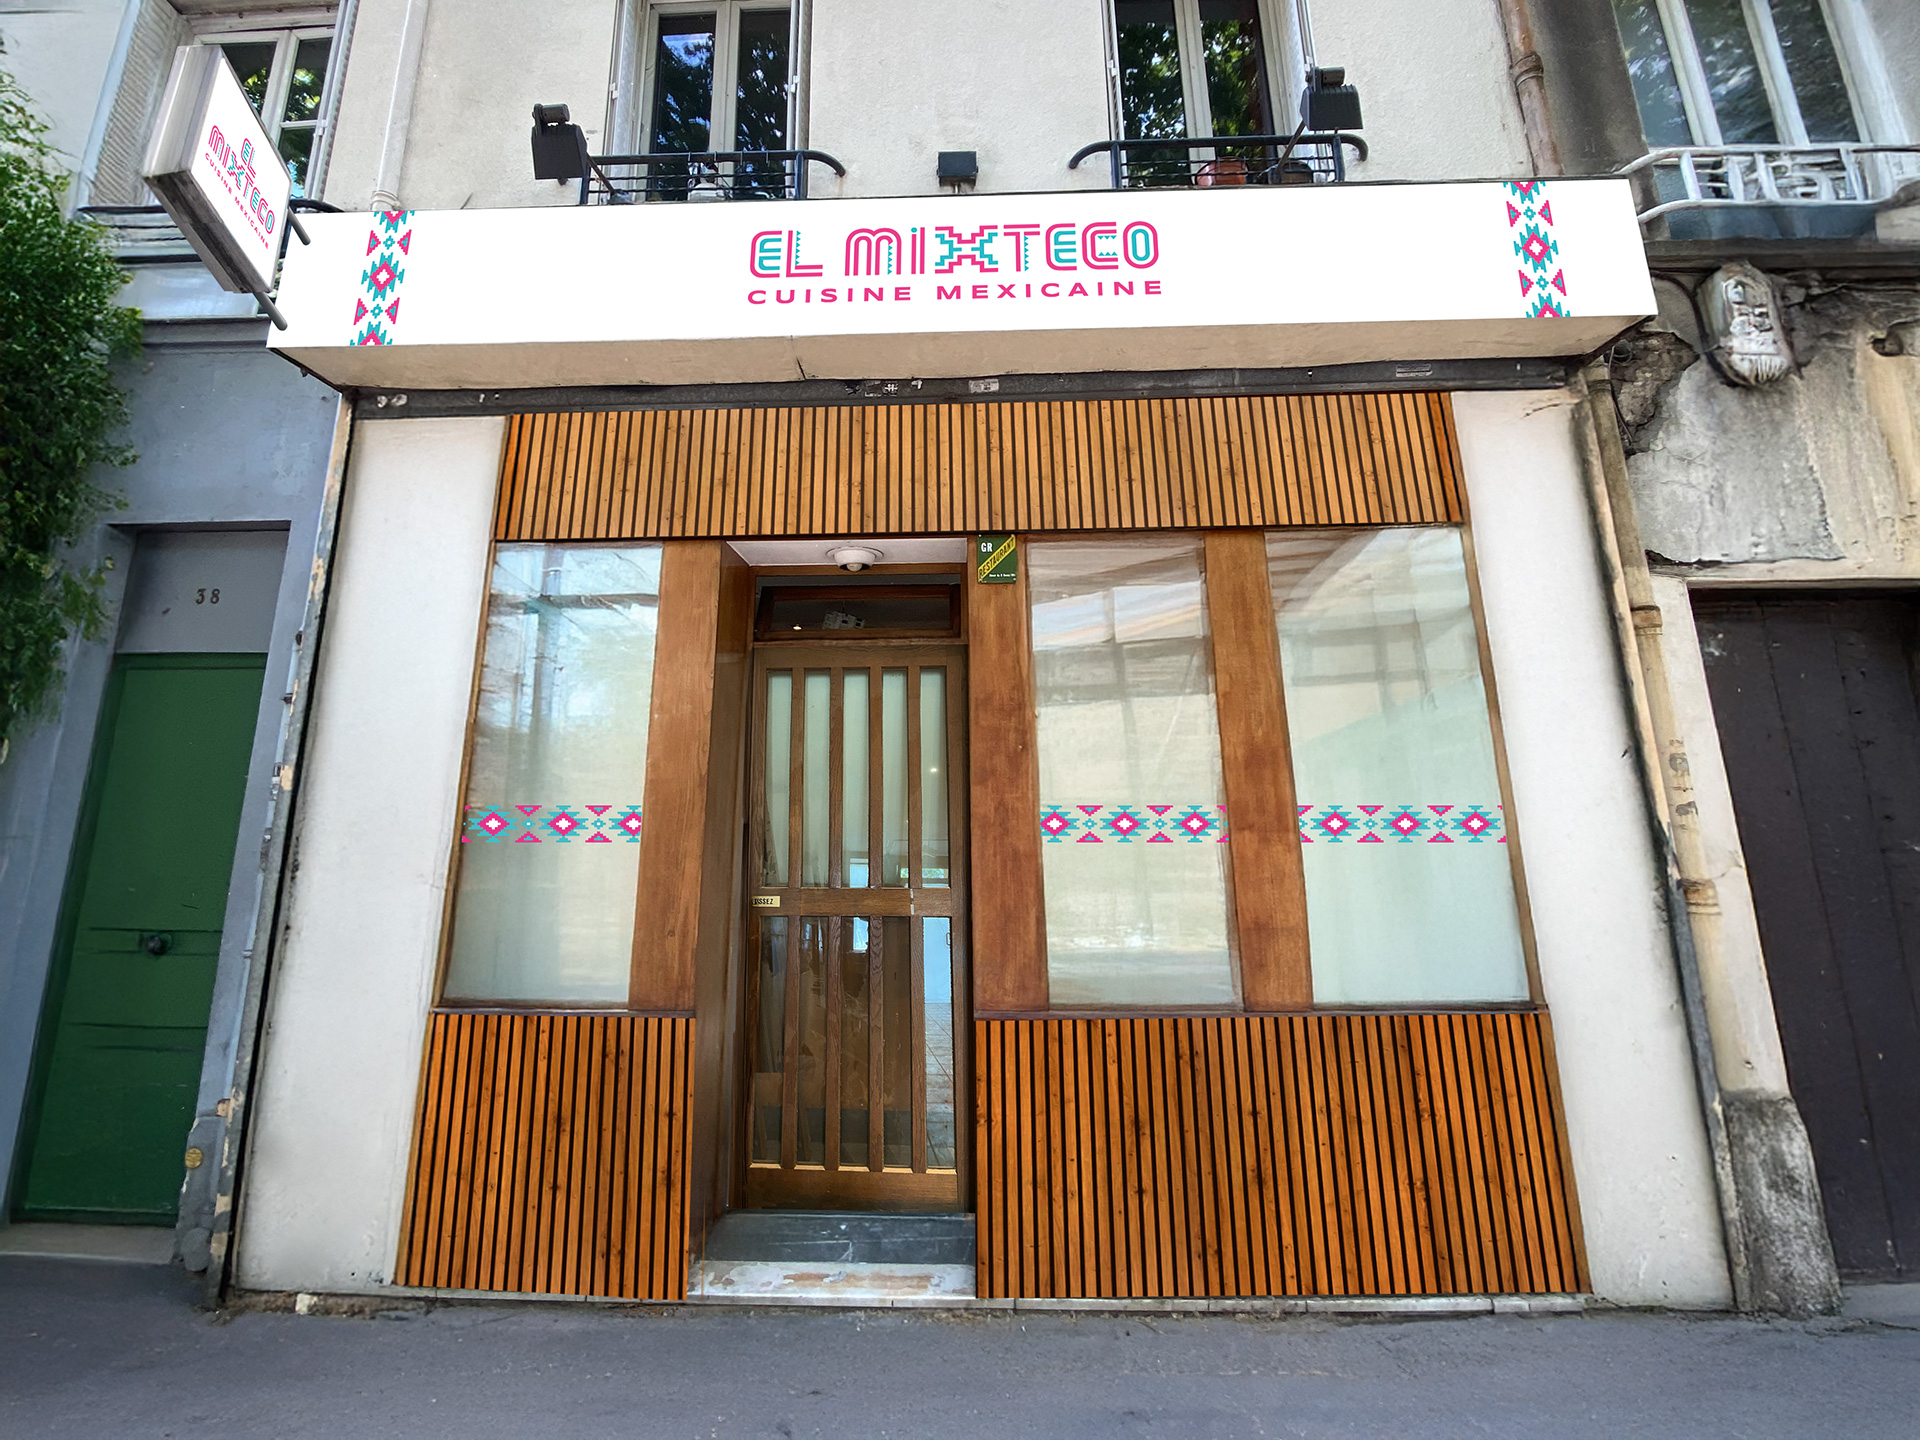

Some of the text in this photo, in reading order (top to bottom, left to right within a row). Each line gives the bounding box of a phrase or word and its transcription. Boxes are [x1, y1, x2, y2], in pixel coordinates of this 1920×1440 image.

[241, 138, 256, 178] EL
[205, 152, 269, 249] CUISINE MEXICAINE
[750, 230, 823, 278] EL
[747, 281, 1161, 304] CUISINE MEXICAINE
[979, 538, 1015, 578] RESTAURANT
[981, 542, 993, 552] GR
[195, 588, 220, 604] 38
